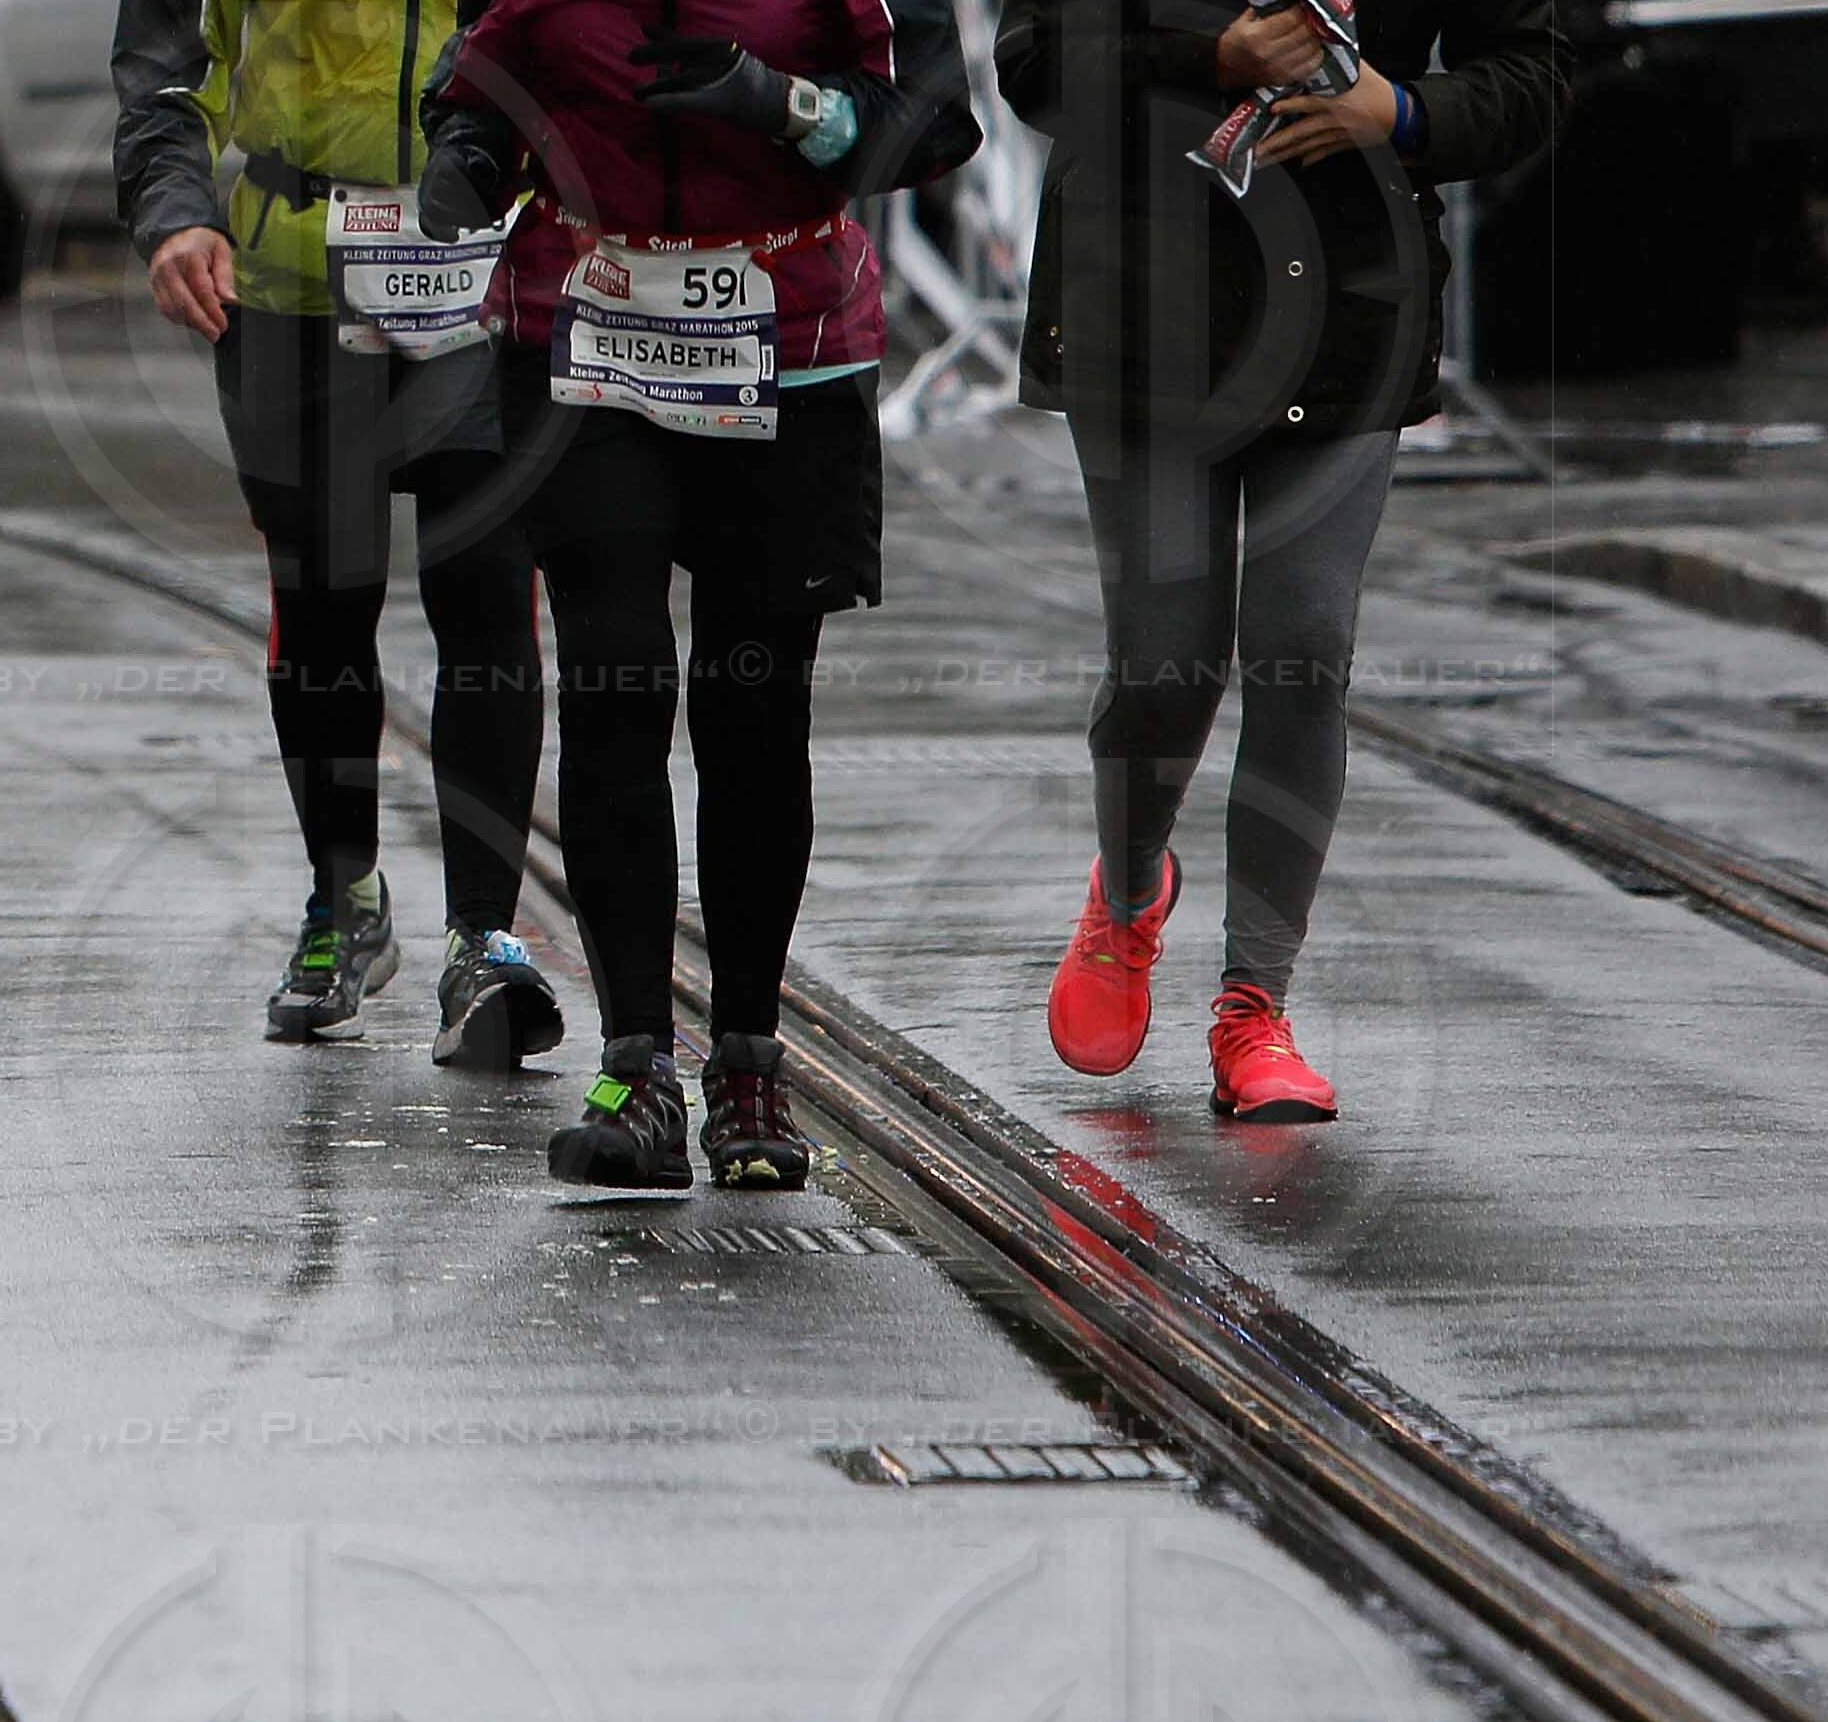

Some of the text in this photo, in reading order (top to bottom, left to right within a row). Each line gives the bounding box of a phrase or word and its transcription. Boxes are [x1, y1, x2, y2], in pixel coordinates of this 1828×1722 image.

[345, 220, 397, 231] ZEITUNG
[347, 207, 398, 221] KLEINE
[344, 249, 374, 261] KLEINE
[377, 249, 416, 261] ZEITUNG
[418, 249, 442, 261] GRAZ
[385, 269, 474, 297] GERALD
[606, 312, 649, 328] ZEITUNG
[680, 321, 735, 335] MARATHON
[736, 318, 760, 334] 2015
[596, 335, 738, 368] ELISABETH
[569, 366, 606, 380] Kleine
[649, 388, 704, 401] Marathon
